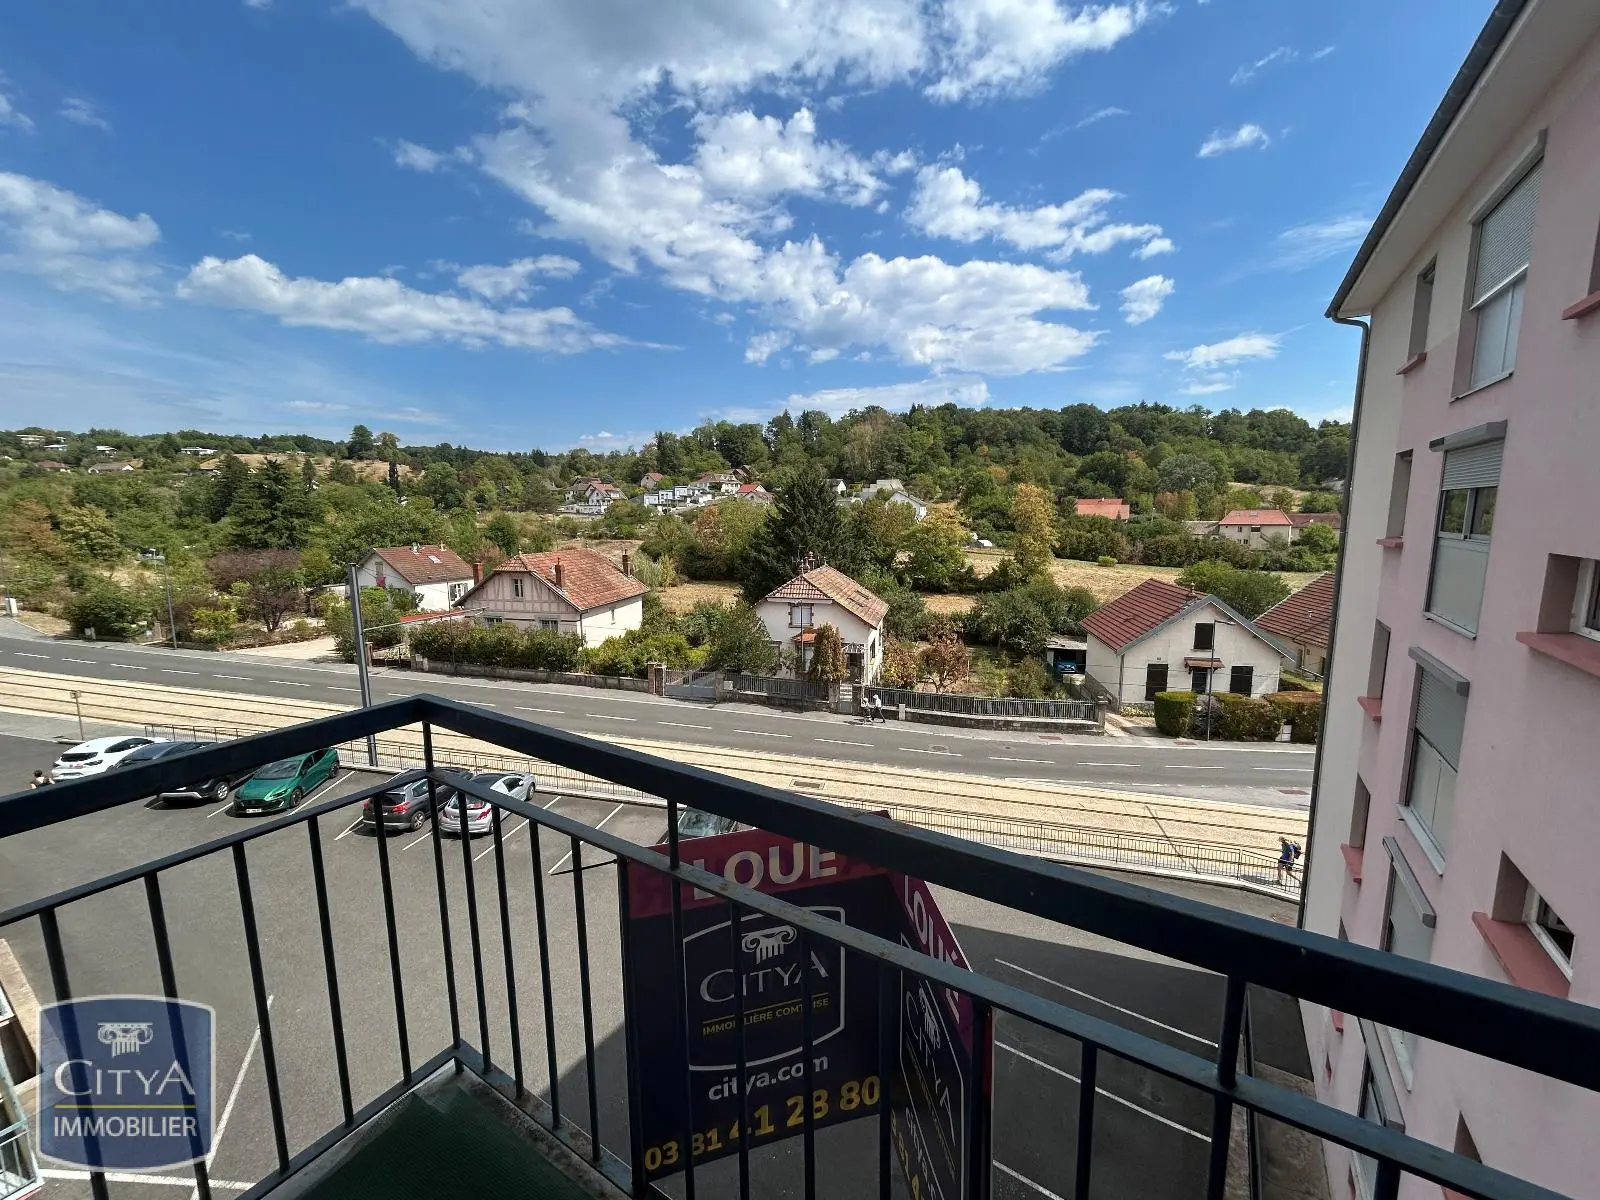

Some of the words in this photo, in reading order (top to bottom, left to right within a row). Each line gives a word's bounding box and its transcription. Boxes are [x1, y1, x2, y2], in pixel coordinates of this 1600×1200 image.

[644, 1140, 680, 1170] 03
[691, 1127, 723, 1156] 81
[786, 1088, 829, 1128] 28
[839, 1075, 881, 1111] 80
